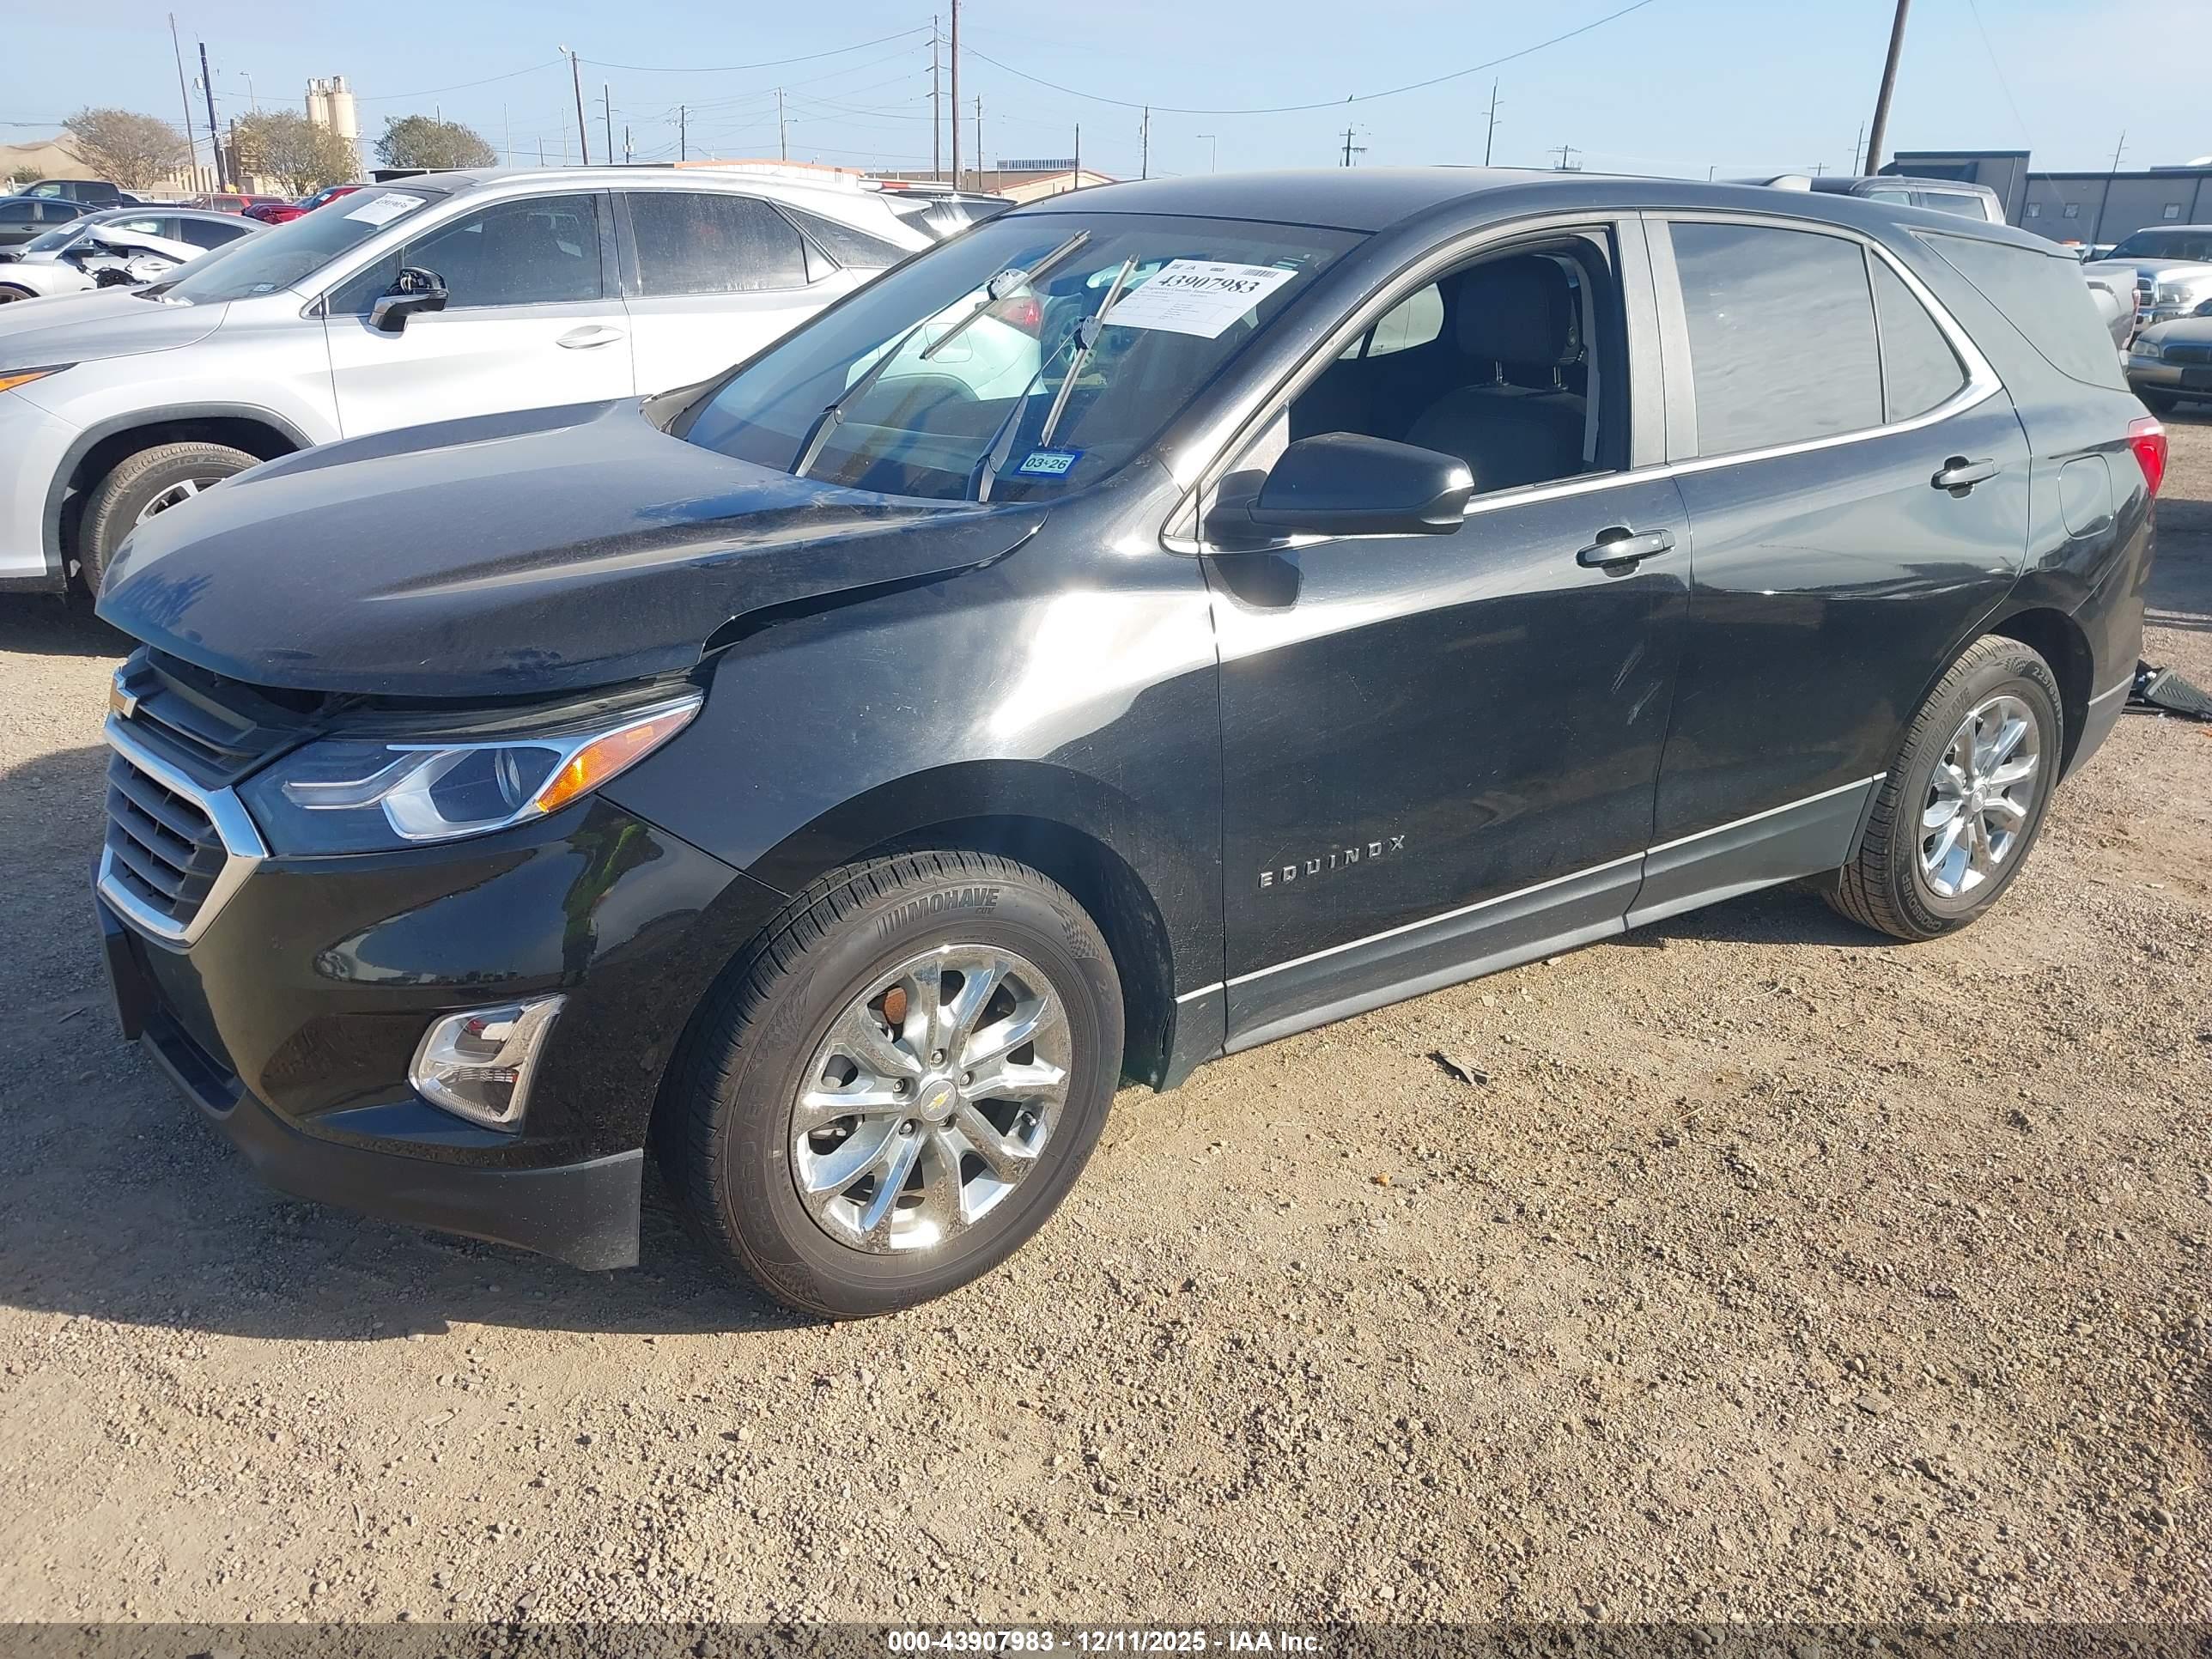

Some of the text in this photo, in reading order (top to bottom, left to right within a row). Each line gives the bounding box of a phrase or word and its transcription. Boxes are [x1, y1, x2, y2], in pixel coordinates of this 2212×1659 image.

[1158, 273, 1261, 294] 43907983
[1025, 458, 1069, 470] 03 26
[1258, 835, 1406, 889] EQUINOX
[907, 888, 1000, 923] MOHAVE
